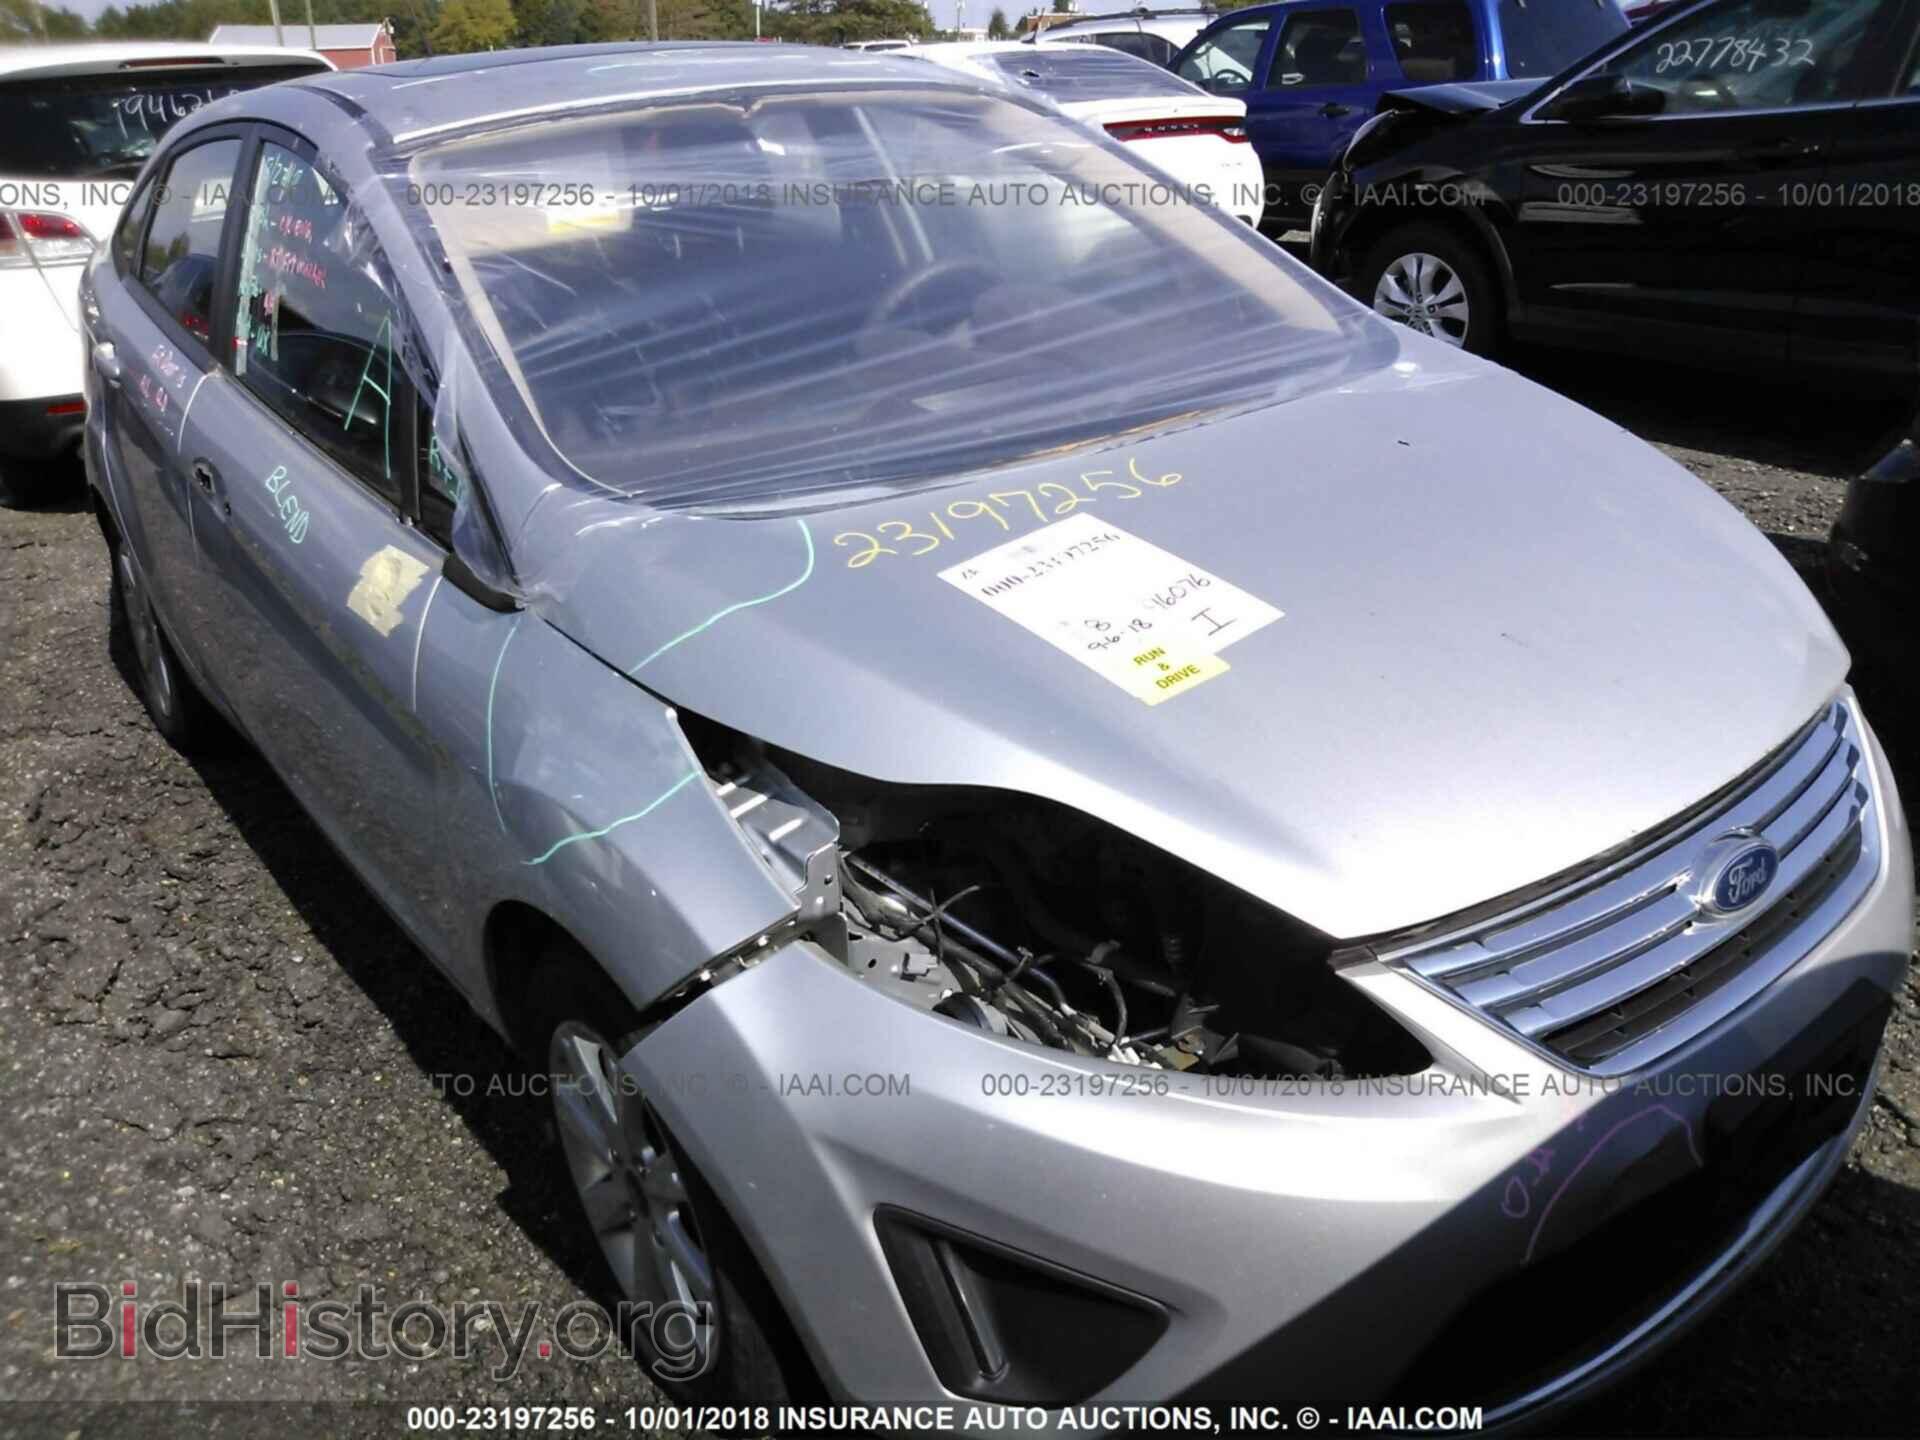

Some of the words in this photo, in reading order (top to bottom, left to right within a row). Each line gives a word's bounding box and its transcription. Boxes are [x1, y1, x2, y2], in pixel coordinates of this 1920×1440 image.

[1656, 36, 1815, 73] 22778432
[264, 464, 311, 544] BLEND
[834, 458, 1183, 568] 23197256
[1133, 646, 1167, 666] RUN
[1157, 662, 1171, 672] &
[1154, 663, 1201, 690] DRIVE
[1728, 856, 1768, 904] Ford
